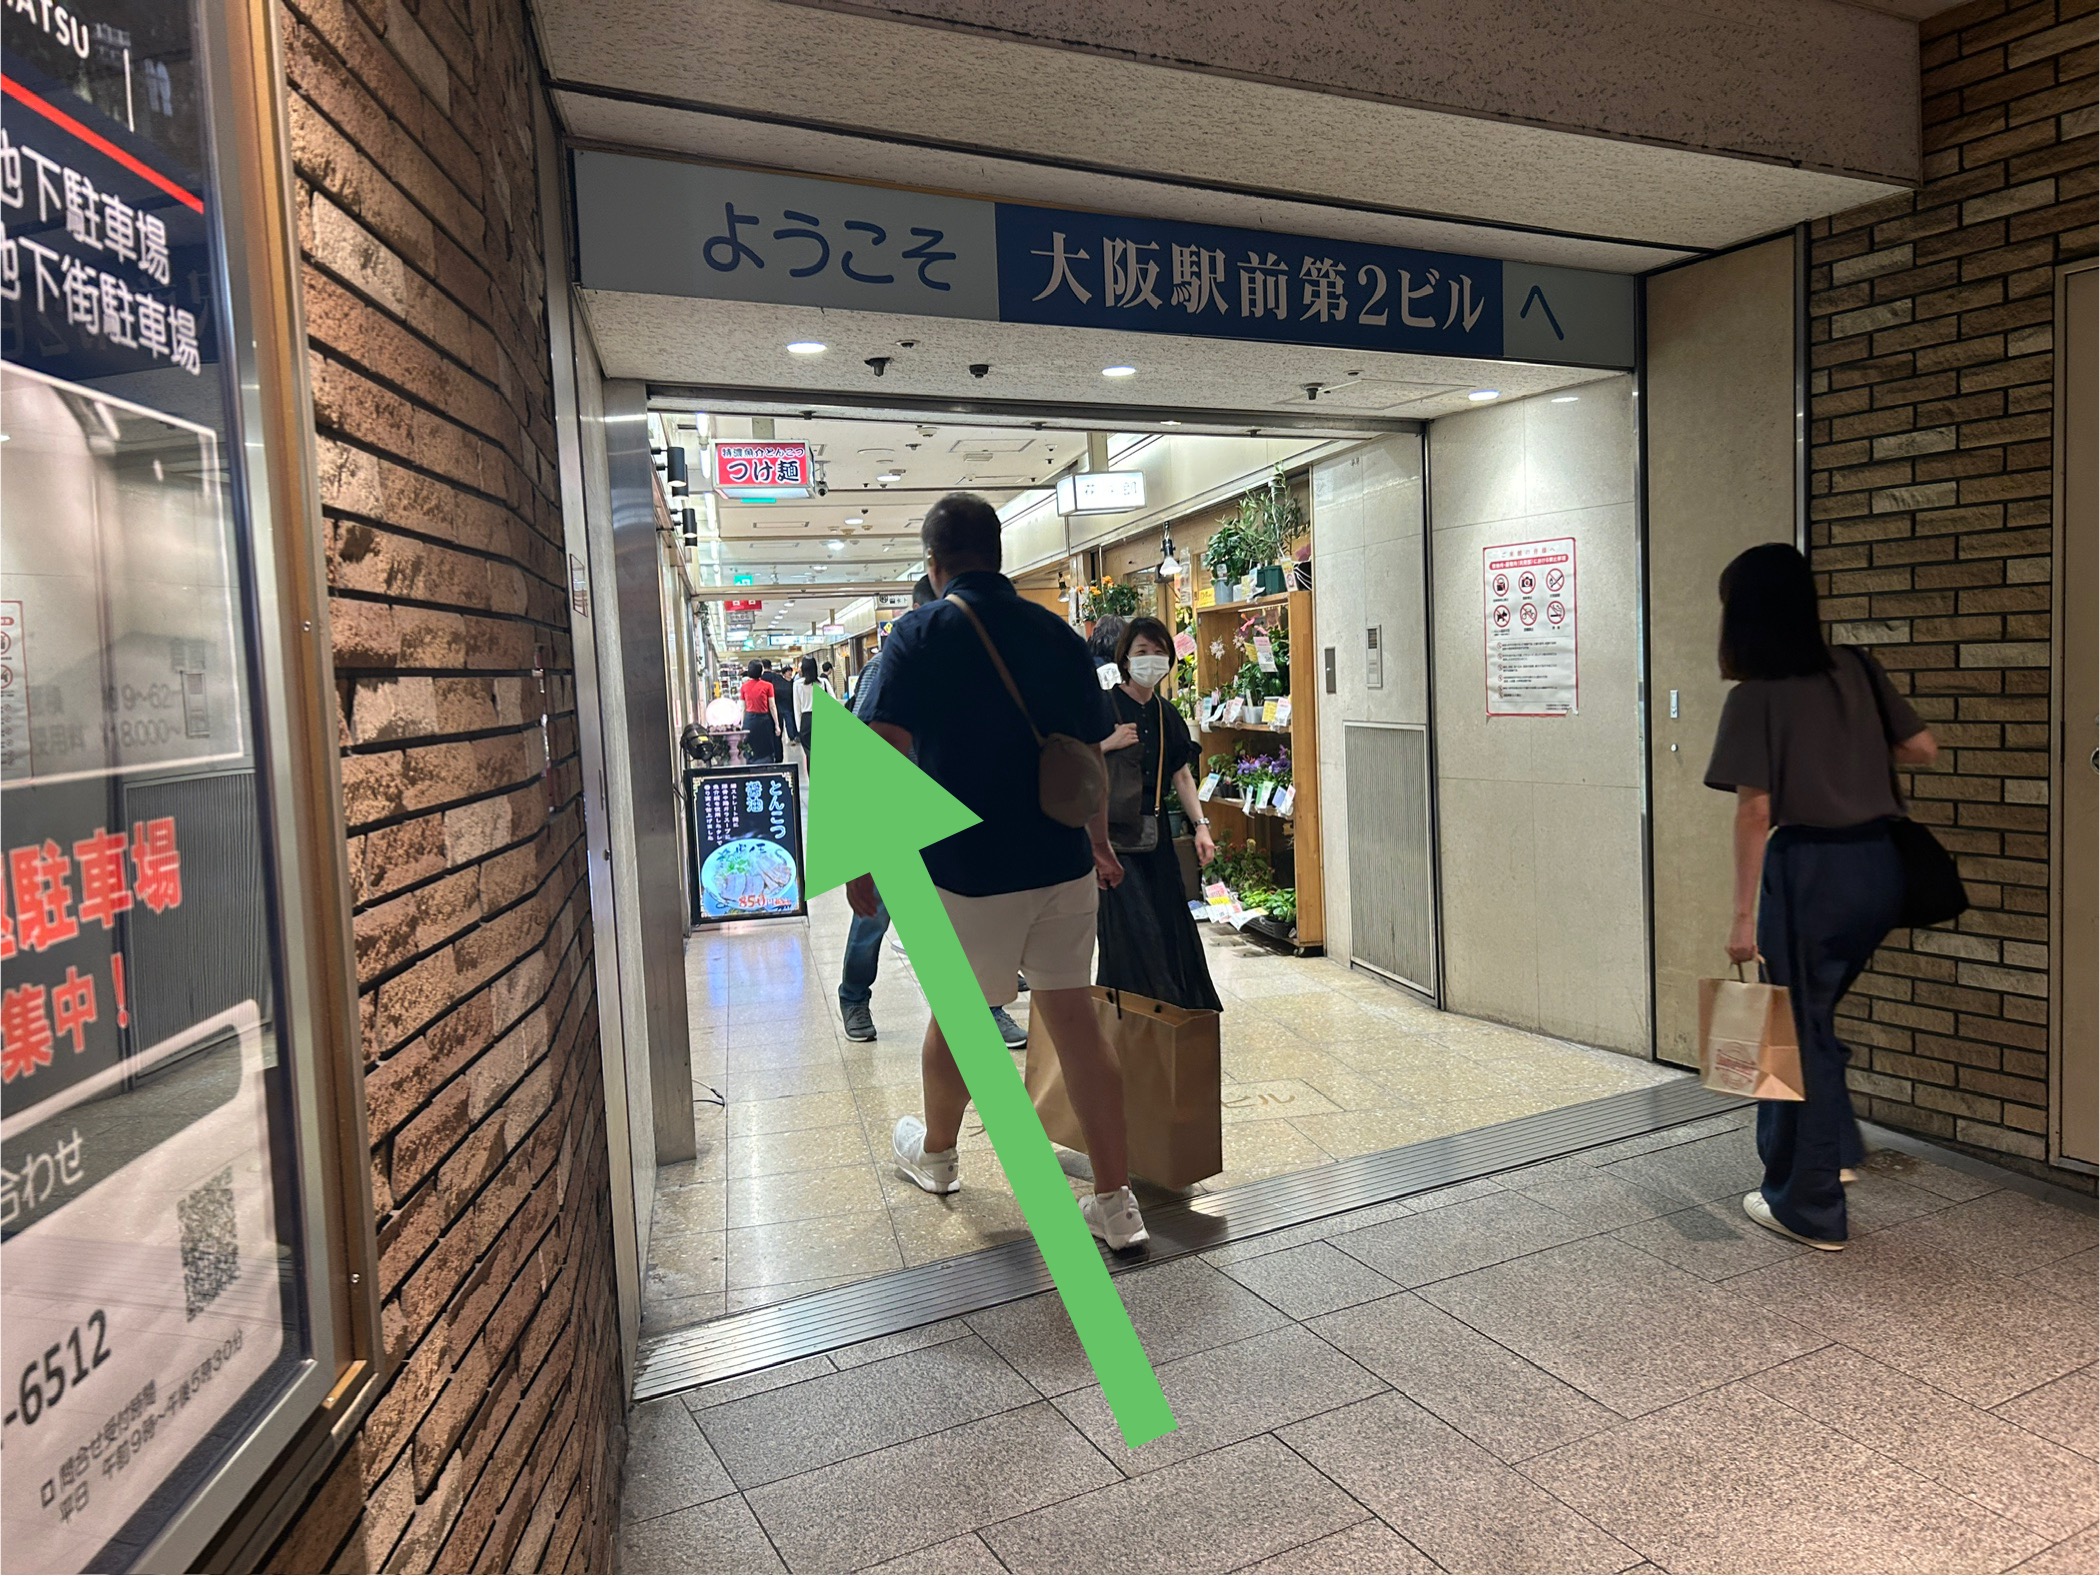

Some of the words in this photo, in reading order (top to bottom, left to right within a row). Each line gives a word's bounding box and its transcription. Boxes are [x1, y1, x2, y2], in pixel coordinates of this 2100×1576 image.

[7, 0, 89, 59] ATSU
[703, 202, 956, 291] ようこそ
[1030, 231, 1485, 333] 大阪駅前第2ビル
[1520, 284, 1565, 341] へ
[727, 460, 801, 483] つけ麺
[768, 780, 787, 839] とんこつ
[4, 1309, 112, 1416] -6512
